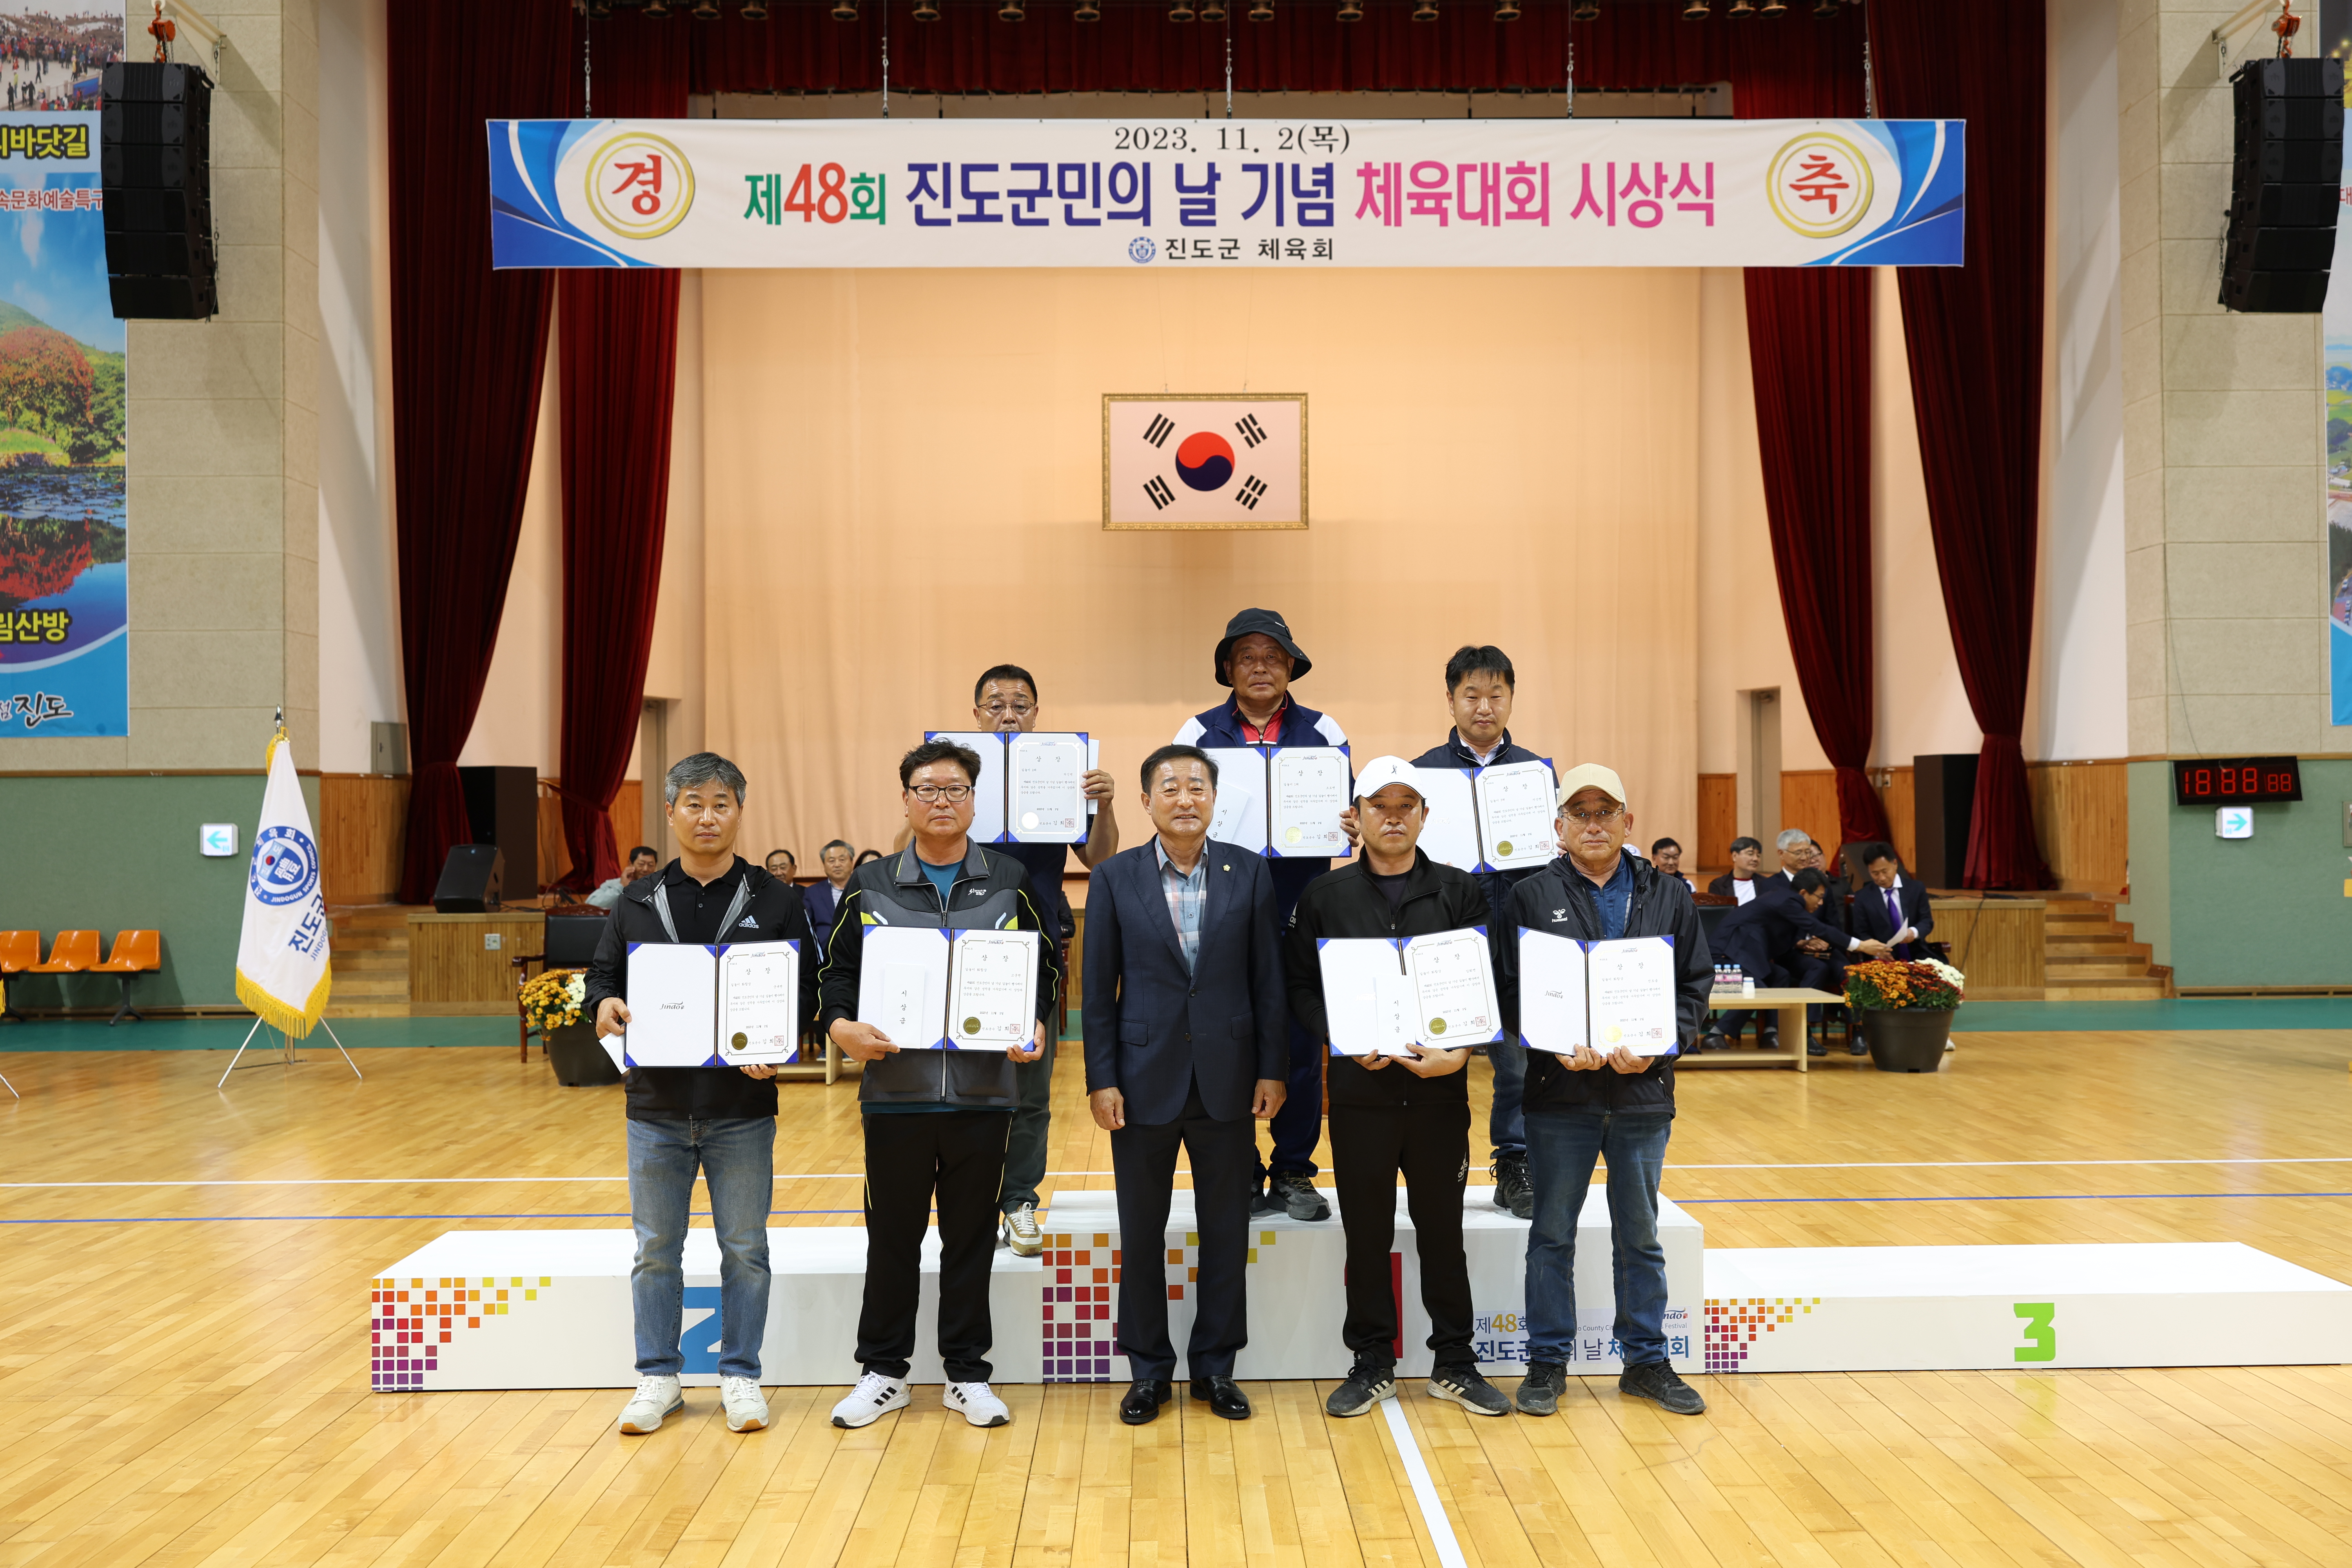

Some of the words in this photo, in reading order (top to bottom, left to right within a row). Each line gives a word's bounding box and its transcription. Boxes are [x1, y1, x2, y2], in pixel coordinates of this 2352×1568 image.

[1115, 127, 1197, 152] 2023.
[1217, 127, 1260, 152] 11.
[1279, 124, 1350, 154] 2(목)
[612, 154, 661, 215] 경
[744, 162, 886, 225] 제48회
[906, 162, 1151, 227] 진도군민의
[1175, 162, 1221, 227] 날
[1241, 162, 1334, 227] 기념
[1355, 160, 1549, 227] 체육대회
[1570, 162, 1714, 228] 시상식
[1789, 154, 1849, 214] 축
[1165, 238, 1240, 260] 진도군
[1258, 238, 1332, 260] 체육회
[15, 693, 72, 726] 진도
[271, 891, 303, 902] JINDOGUN
[302, 871, 316, 893] SPORTS
[311, 928, 328, 961] JINDOG
[2014, 1303, 2056, 1362] 3
[1584, 1338, 1603, 1361] 날
